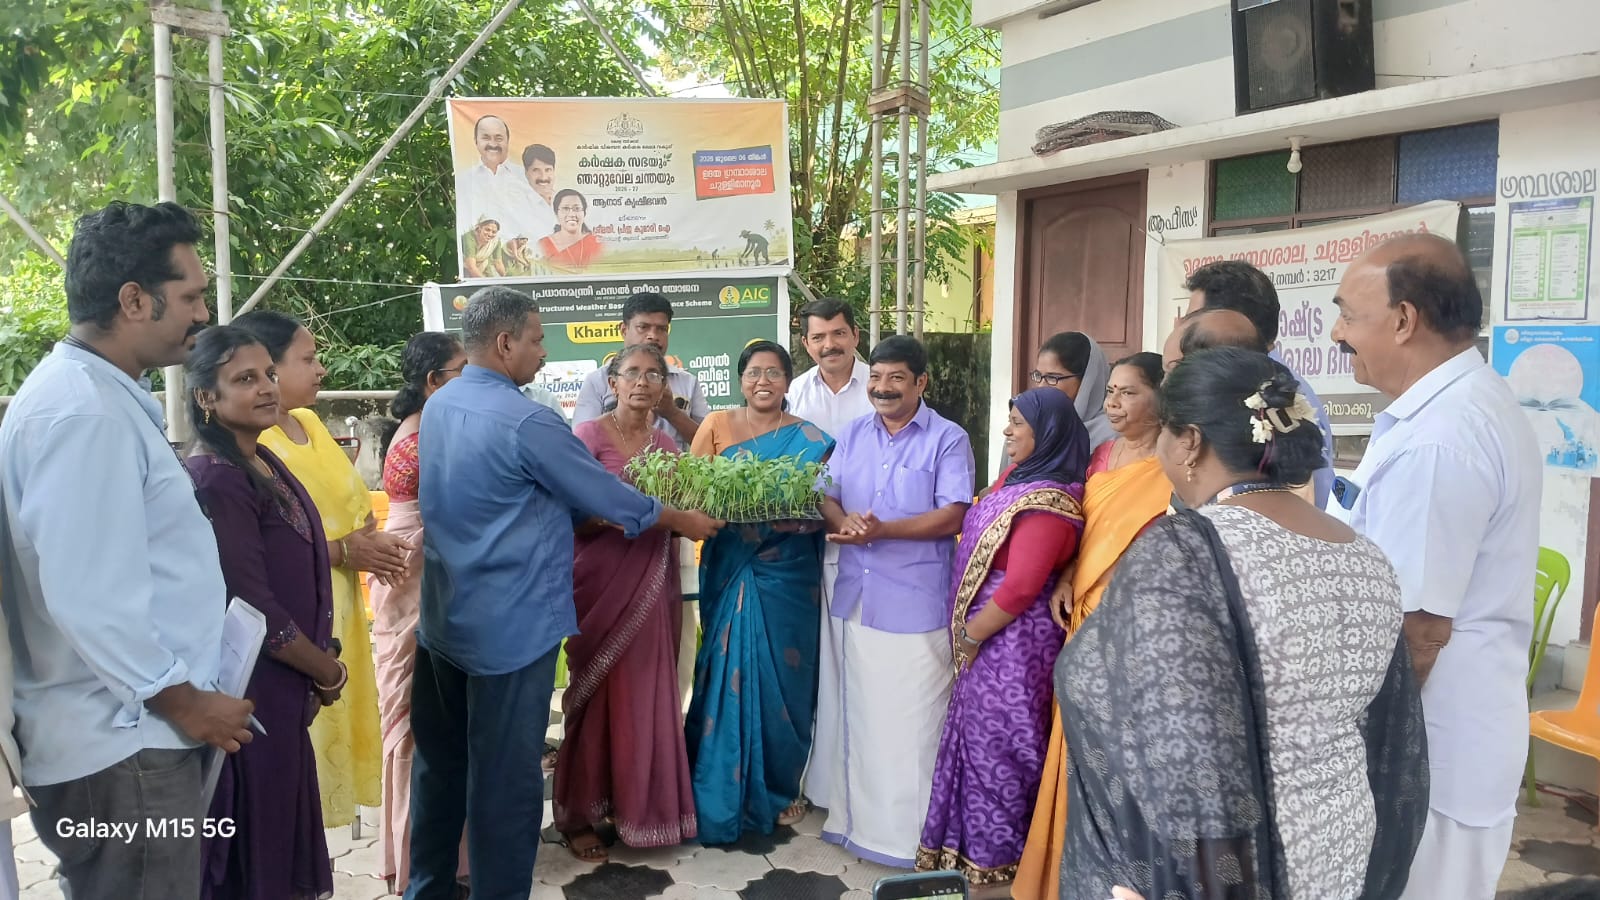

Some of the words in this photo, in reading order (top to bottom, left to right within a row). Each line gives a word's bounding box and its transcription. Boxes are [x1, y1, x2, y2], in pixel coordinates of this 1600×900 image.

[579, 154, 625, 168] കർഷക
[628, 157, 667, 169] സഭയും
[577, 173, 633, 187] ഞാറ്റുവേല
[635, 173, 675, 185] ചന്തയും
[1313, 268, 1337, 282] 3217
[532, 285, 593, 300] പ്രധാനമന്ത്രി
[596, 284, 630, 296] ഫസൽ
[742, 287, 769, 300] AIC
[685, 299, 712, 307] Scheme
[573, 324, 620, 339] Kharif
[689, 353, 730, 368] ഫസൽ
